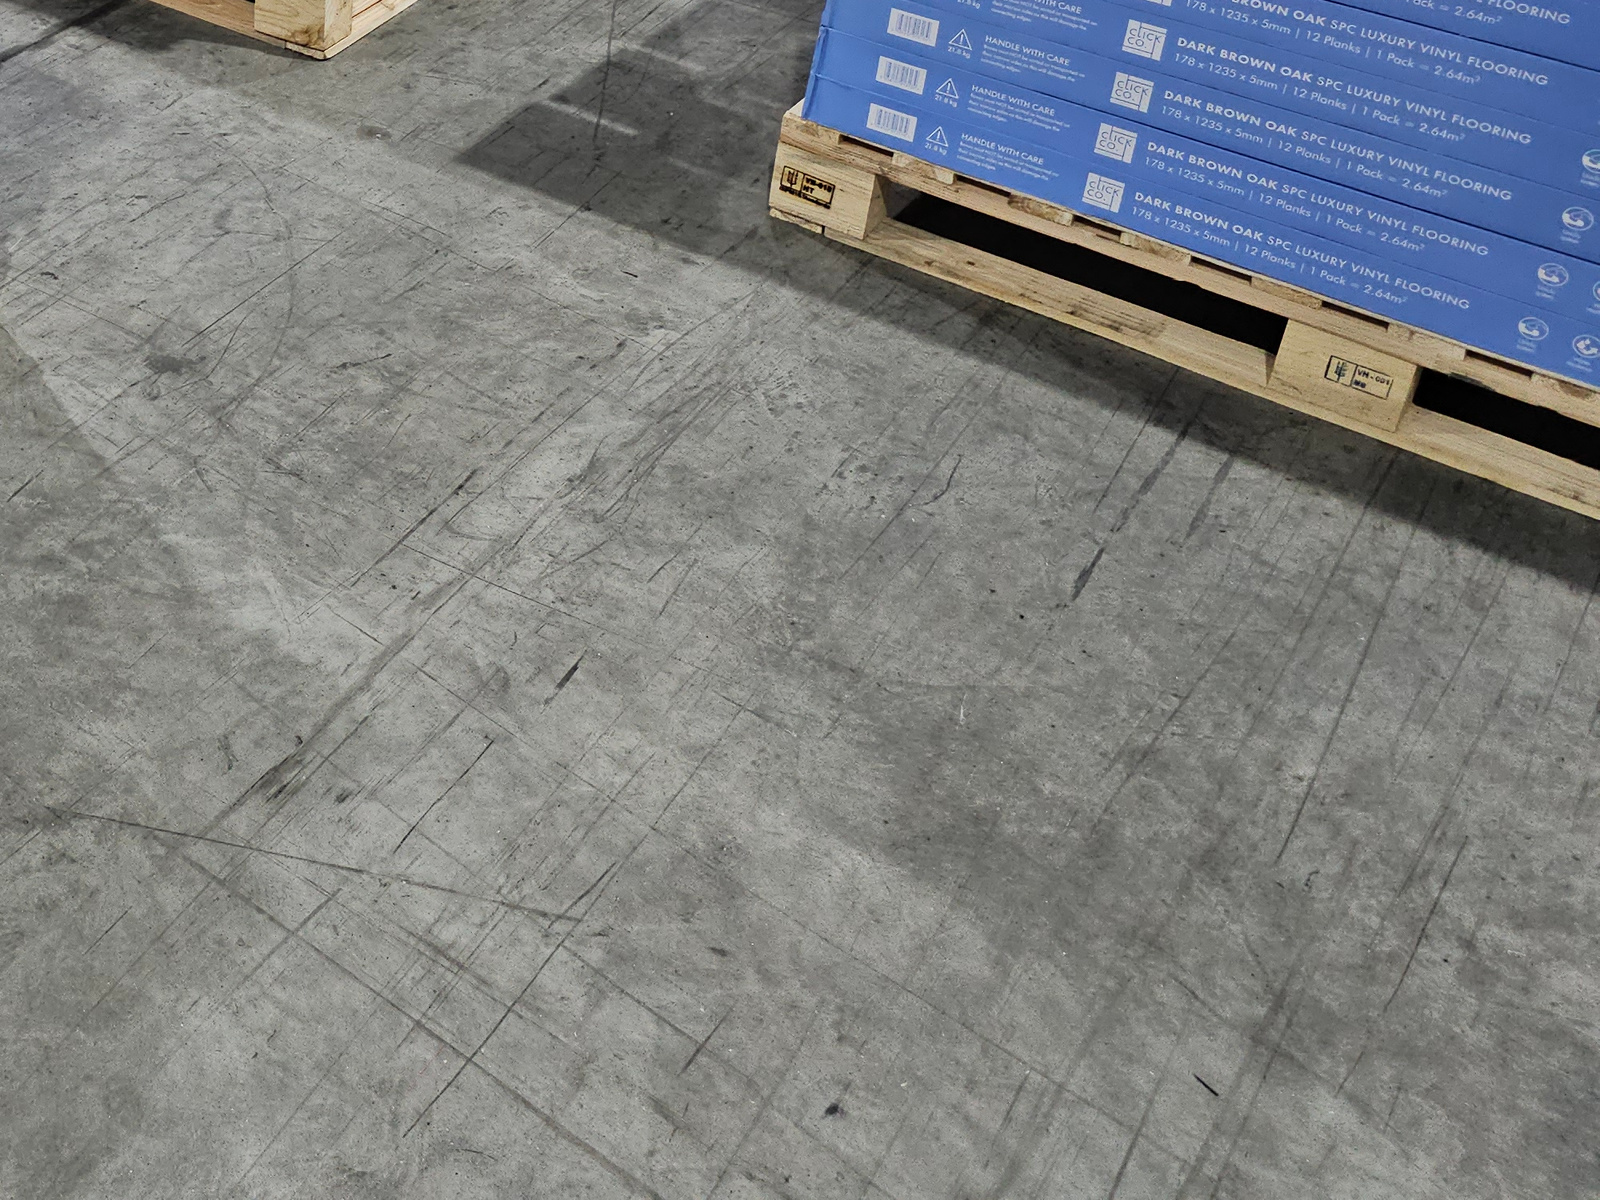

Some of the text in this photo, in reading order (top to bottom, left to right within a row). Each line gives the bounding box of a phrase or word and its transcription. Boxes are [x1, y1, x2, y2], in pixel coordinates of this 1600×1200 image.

[1058, 2, 1082, 14] CARE
[985, 35, 1070, 66] HANDLE WITH CARE
[1130, 28, 1161, 44] CLICK
[1293, 10, 1326, 26] OAK
[1330, 20, 1356, 34] SPC
[1360, 28, 1416, 49] LUXURY
[1420, 43, 1461, 62] VINYL
[1467, 56, 1548, 85] FLOORING
[971, 84, 1054, 116] HANDLE WITH CARE
[1118, 80, 1149, 96] CLICK
[1177, 37, 1531, 144] DARK BROWN OAK SPC LUXURY VINYL FLOORING
[960, 133, 1043, 165] HANDLE WITH CARE
[1102, 130, 1132, 146] CLICK
[1164, 90, 1511, 200] DARK BROWN OAK SPC LUXURY VINYL FLOORING
[1089, 180, 1120, 196] CLICK
[1147, 142, 1488, 255] DARK BROWN OAK SPC LUXURY VINYL FLOORING
[1135, 192, 1469, 309] DARK BROWN OAK SPC LUXURY VINYL FLOORING
